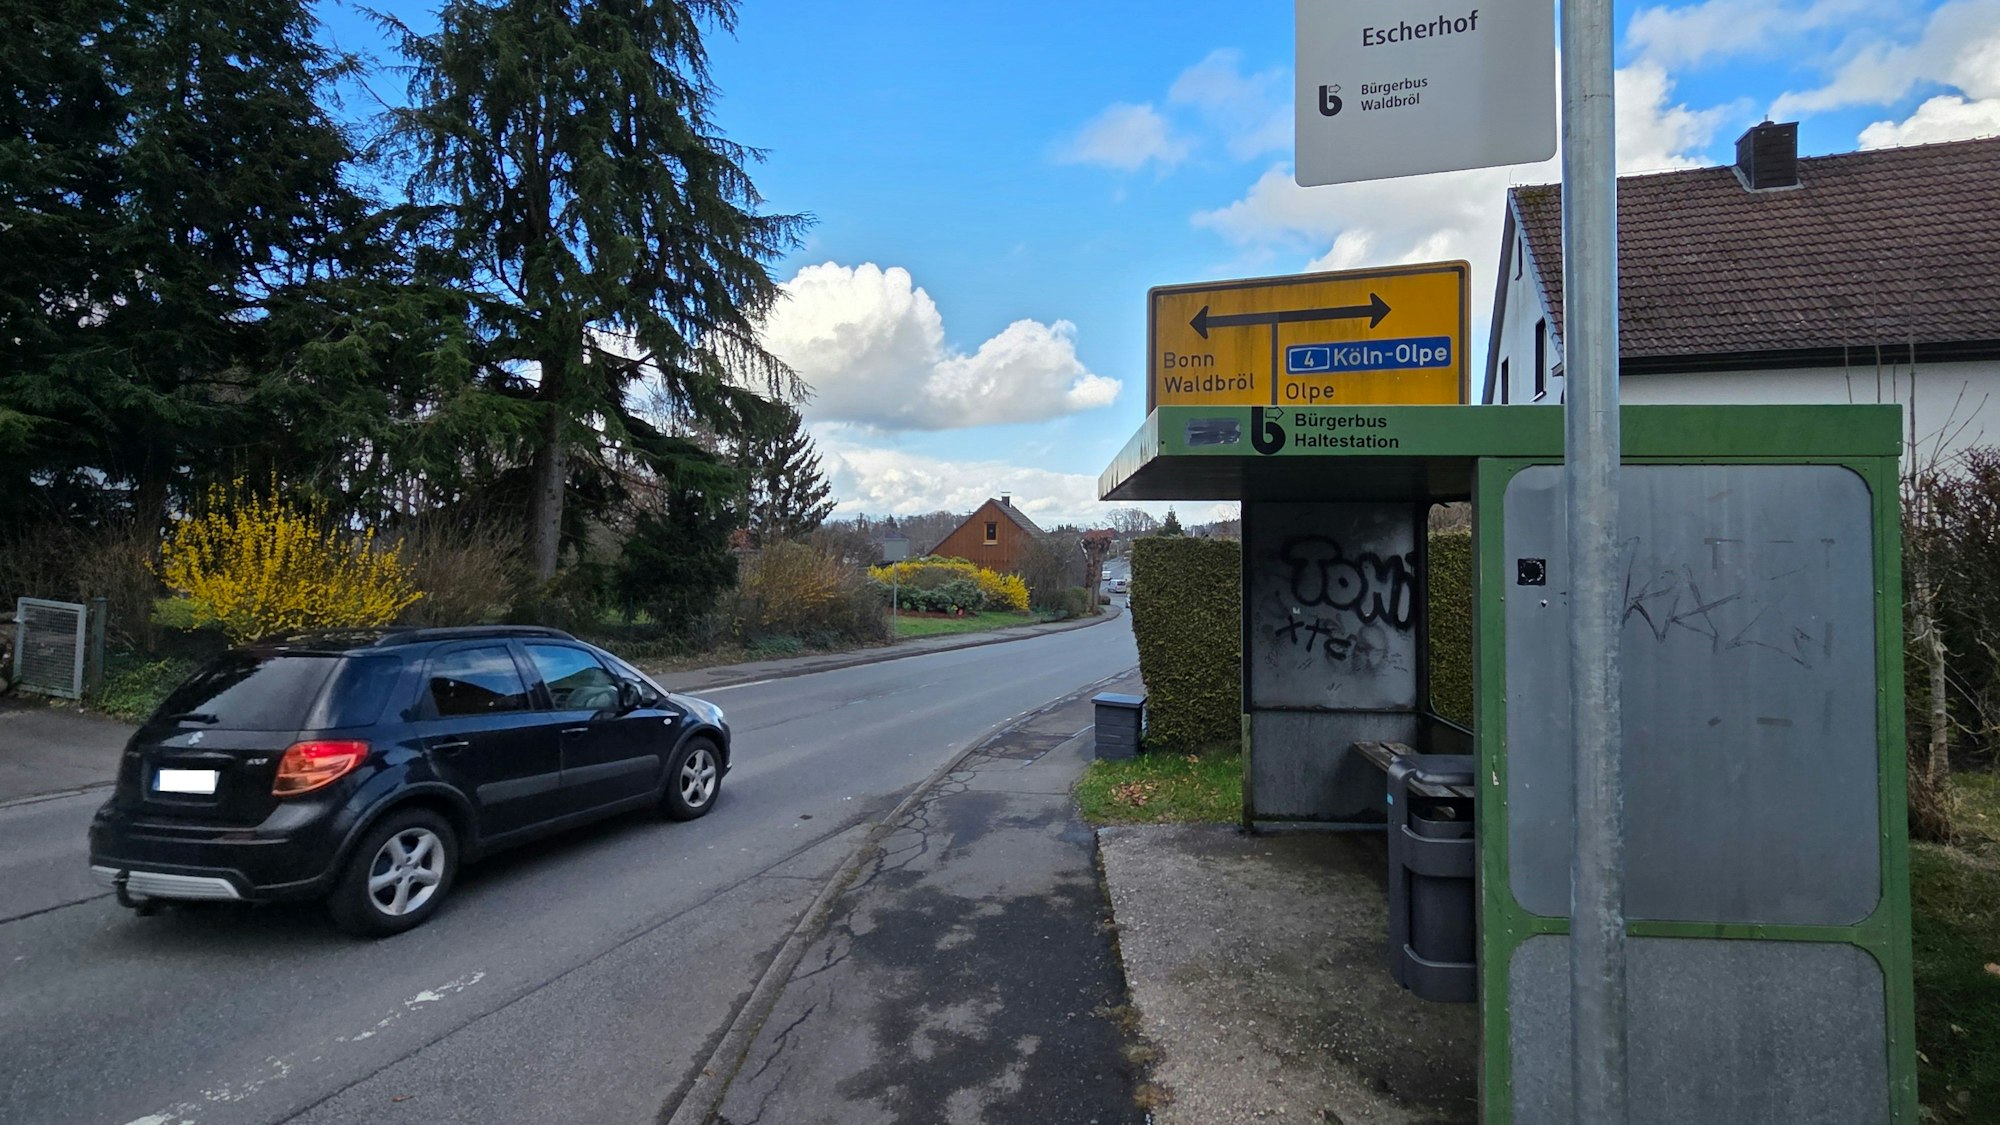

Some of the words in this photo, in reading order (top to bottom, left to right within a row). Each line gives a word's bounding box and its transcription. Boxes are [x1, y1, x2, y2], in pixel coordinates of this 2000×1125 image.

[1362, 9, 1479, 47] Escherhof
[1361, 77, 1428, 95] Bürgerbus
[1361, 93, 1420, 111] Waldbröl
[1163, 352, 1214, 368] Bonn
[1303, 350, 1315, 367] 4
[1333, 343, 1448, 367] Köln-Olpe
[1165, 373, 1254, 393] Waldbröl
[1286, 382, 1335, 403] Olpe
[1295, 413, 1387, 430] Bürgerbus
[1295, 433, 1399, 448] Haltestation
